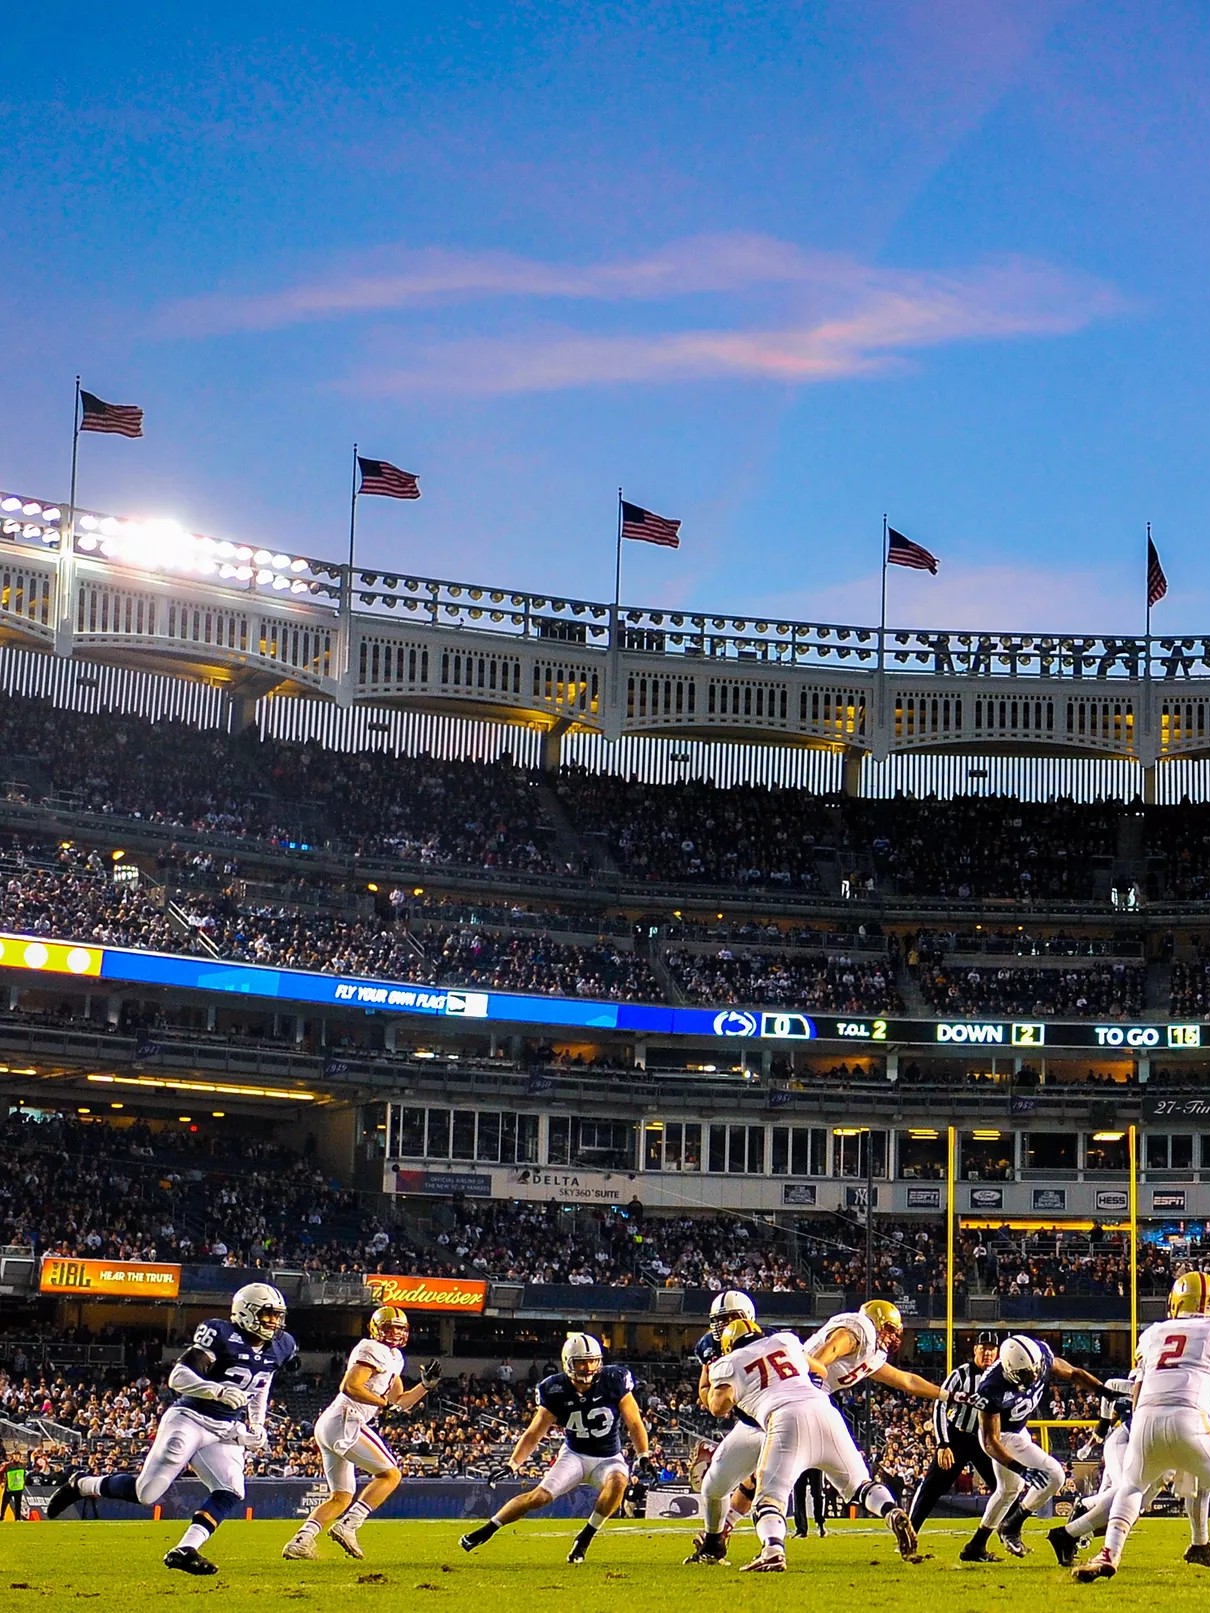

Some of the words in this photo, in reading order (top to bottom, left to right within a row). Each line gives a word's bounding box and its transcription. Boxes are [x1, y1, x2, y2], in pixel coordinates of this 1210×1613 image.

[335, 984, 357, 1000] FLY
[358, 986, 388, 1004] YOUR
[388, 990, 416, 1006] OWN
[416, 993, 447, 1009] FLAG
[872, 1019, 887, 1039] 2
[936, 1023, 1003, 1043] DOWN
[1019, 1025, 1034, 1043] 2
[1095, 1027, 1126, 1046] TO
[1127, 1028, 1159, 1046] GO
[533, 1174, 579, 1187] DELTA
[595, 1188, 619, 1199] SUITE
[909, 1191, 939, 1199] ESPN
[1099, 1196, 1125, 1204] HESS
[1153, 1196, 1184, 1205] ESPN
[50, 1262, 91, 1287] JBL
[100, 1271, 125, 1281] HEAR
[127, 1272, 144, 1282] THE
[367, 1279, 483, 1305] Budweiser
[193, 1324, 217, 1348] 26
[1157, 1334, 1187, 1370] 2
[744, 1350, 800, 1391] 76
[566, 1407, 614, 1438] 43
